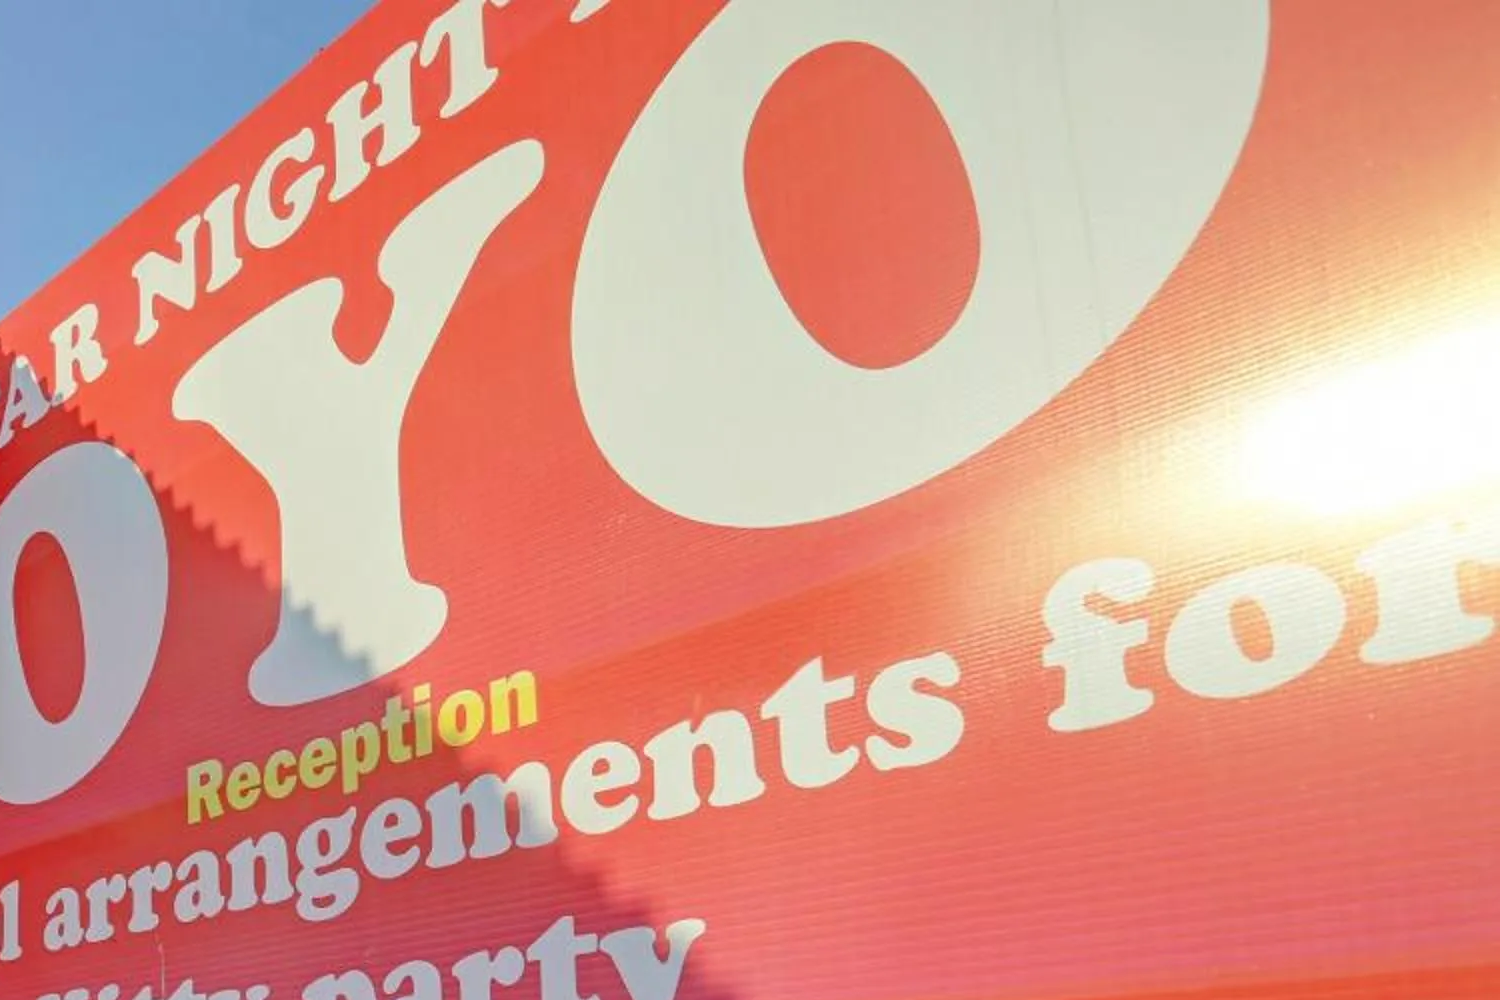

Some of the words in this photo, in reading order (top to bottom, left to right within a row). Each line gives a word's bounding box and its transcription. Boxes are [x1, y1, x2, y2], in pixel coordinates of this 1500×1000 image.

[131, 0, 500, 345] NIGHT
[42, 652, 965, 921] arrangements
[1042, 515, 1500, 733] for
[186, 669, 539, 824] Reception
